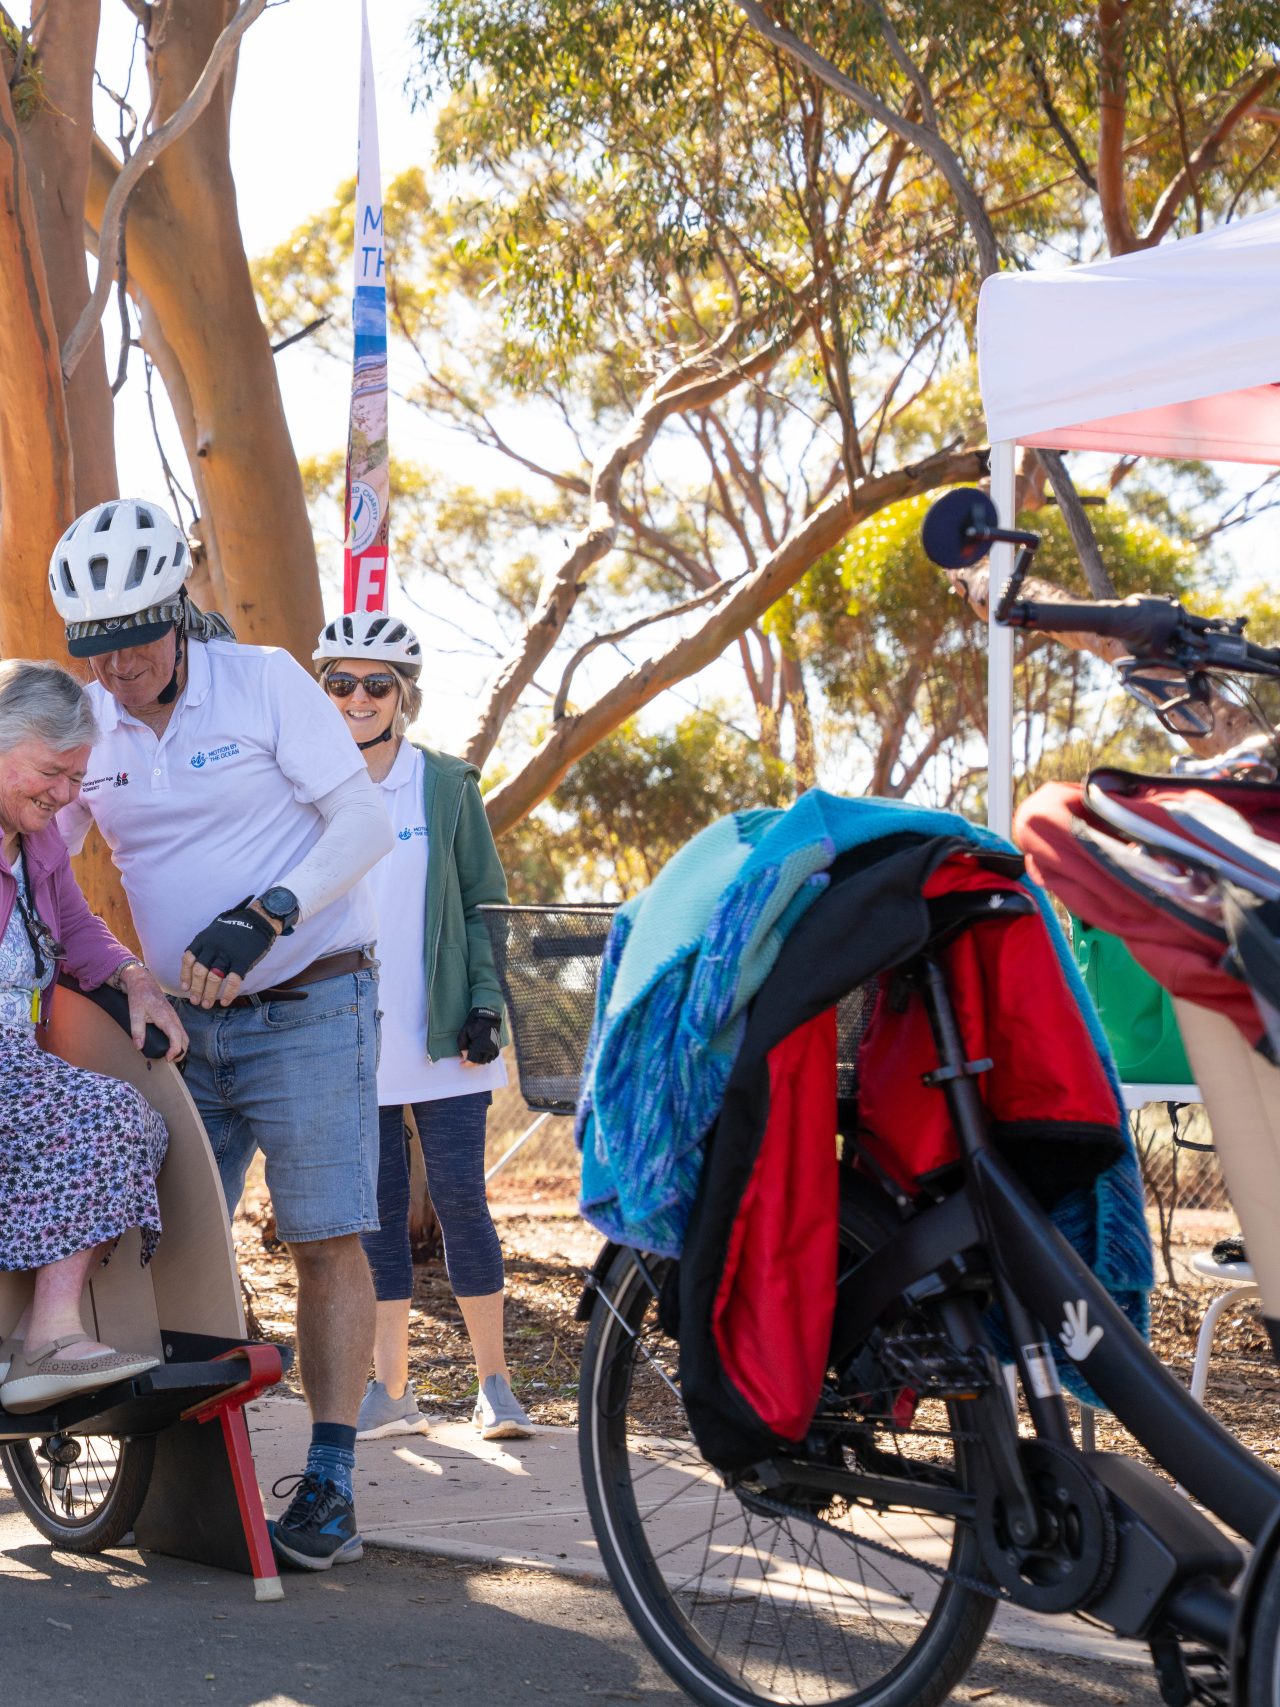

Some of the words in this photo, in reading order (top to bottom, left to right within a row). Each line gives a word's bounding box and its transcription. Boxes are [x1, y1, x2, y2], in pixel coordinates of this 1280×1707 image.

[362, 489, 378, 521] CHARITY
[208, 746, 230, 757] MOTION
[220, 749, 240, 759] OCEAN
